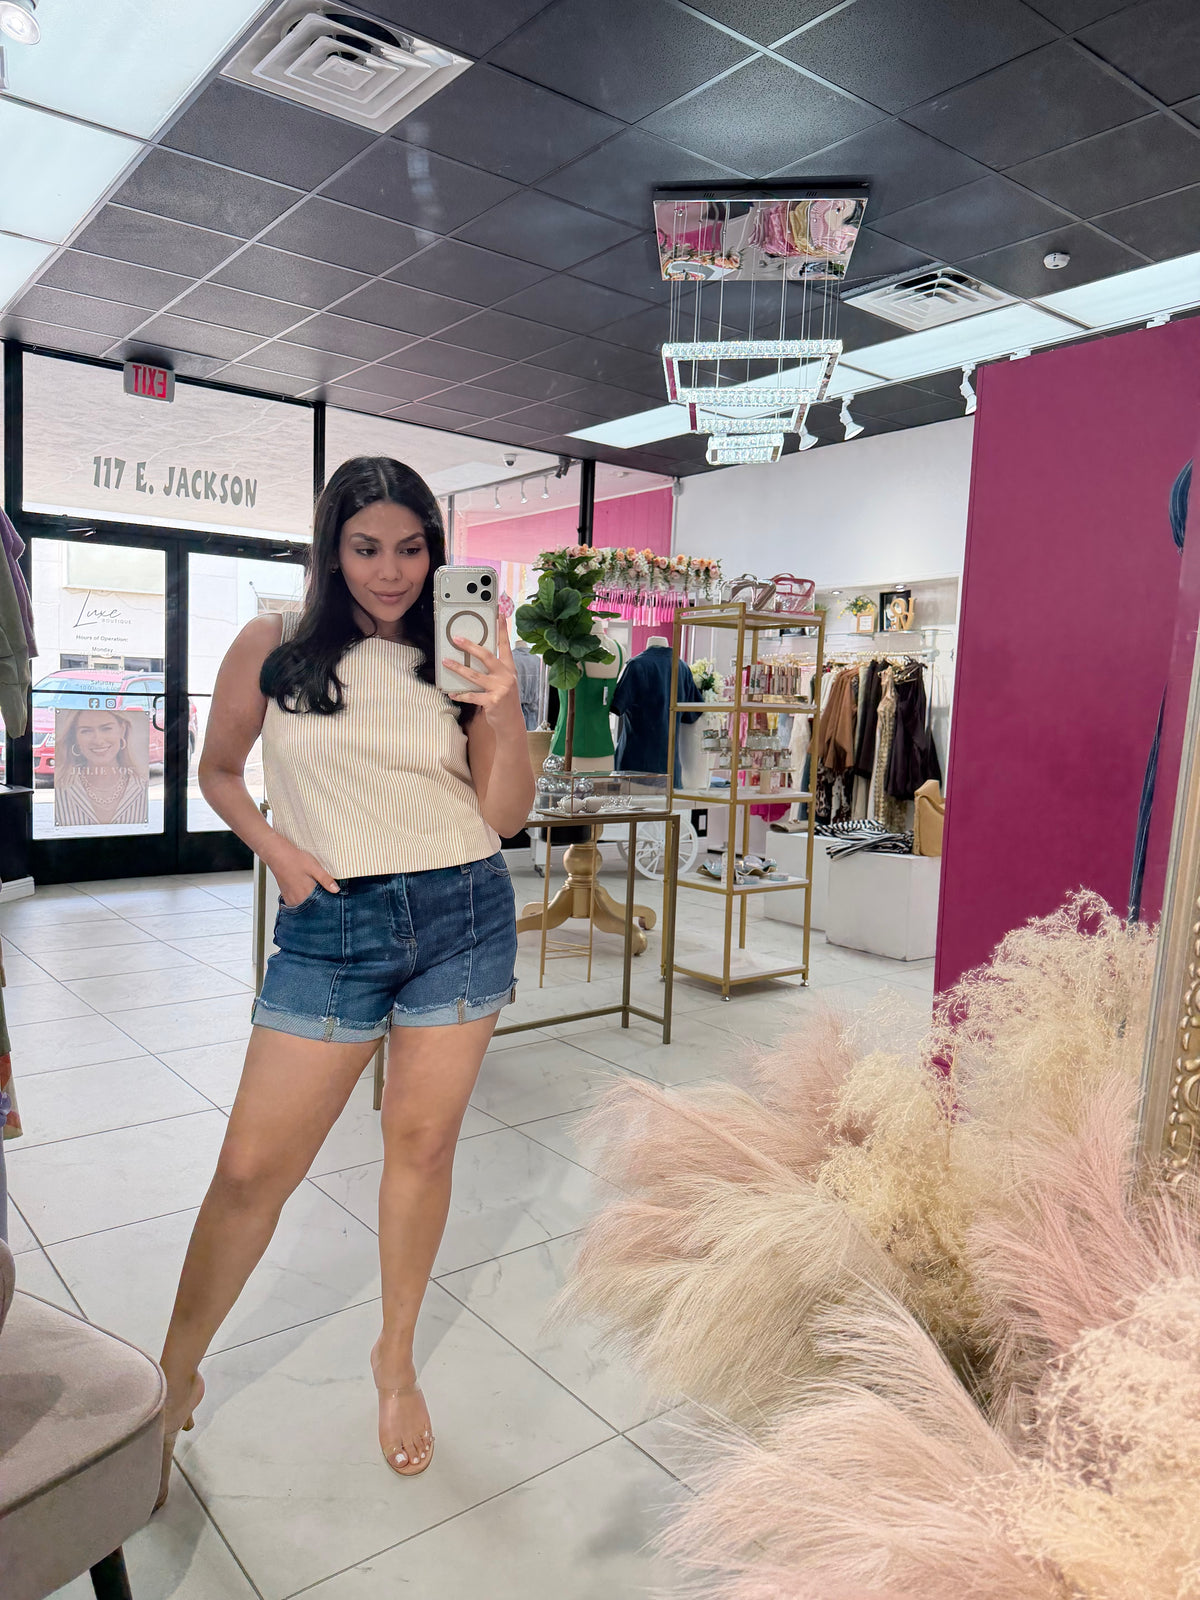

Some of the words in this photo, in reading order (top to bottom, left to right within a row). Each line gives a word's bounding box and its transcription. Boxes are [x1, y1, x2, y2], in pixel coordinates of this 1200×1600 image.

[93, 456, 126, 490] 117
[135, 461, 154, 494] E.
[163, 466, 258, 508] JACKSON
